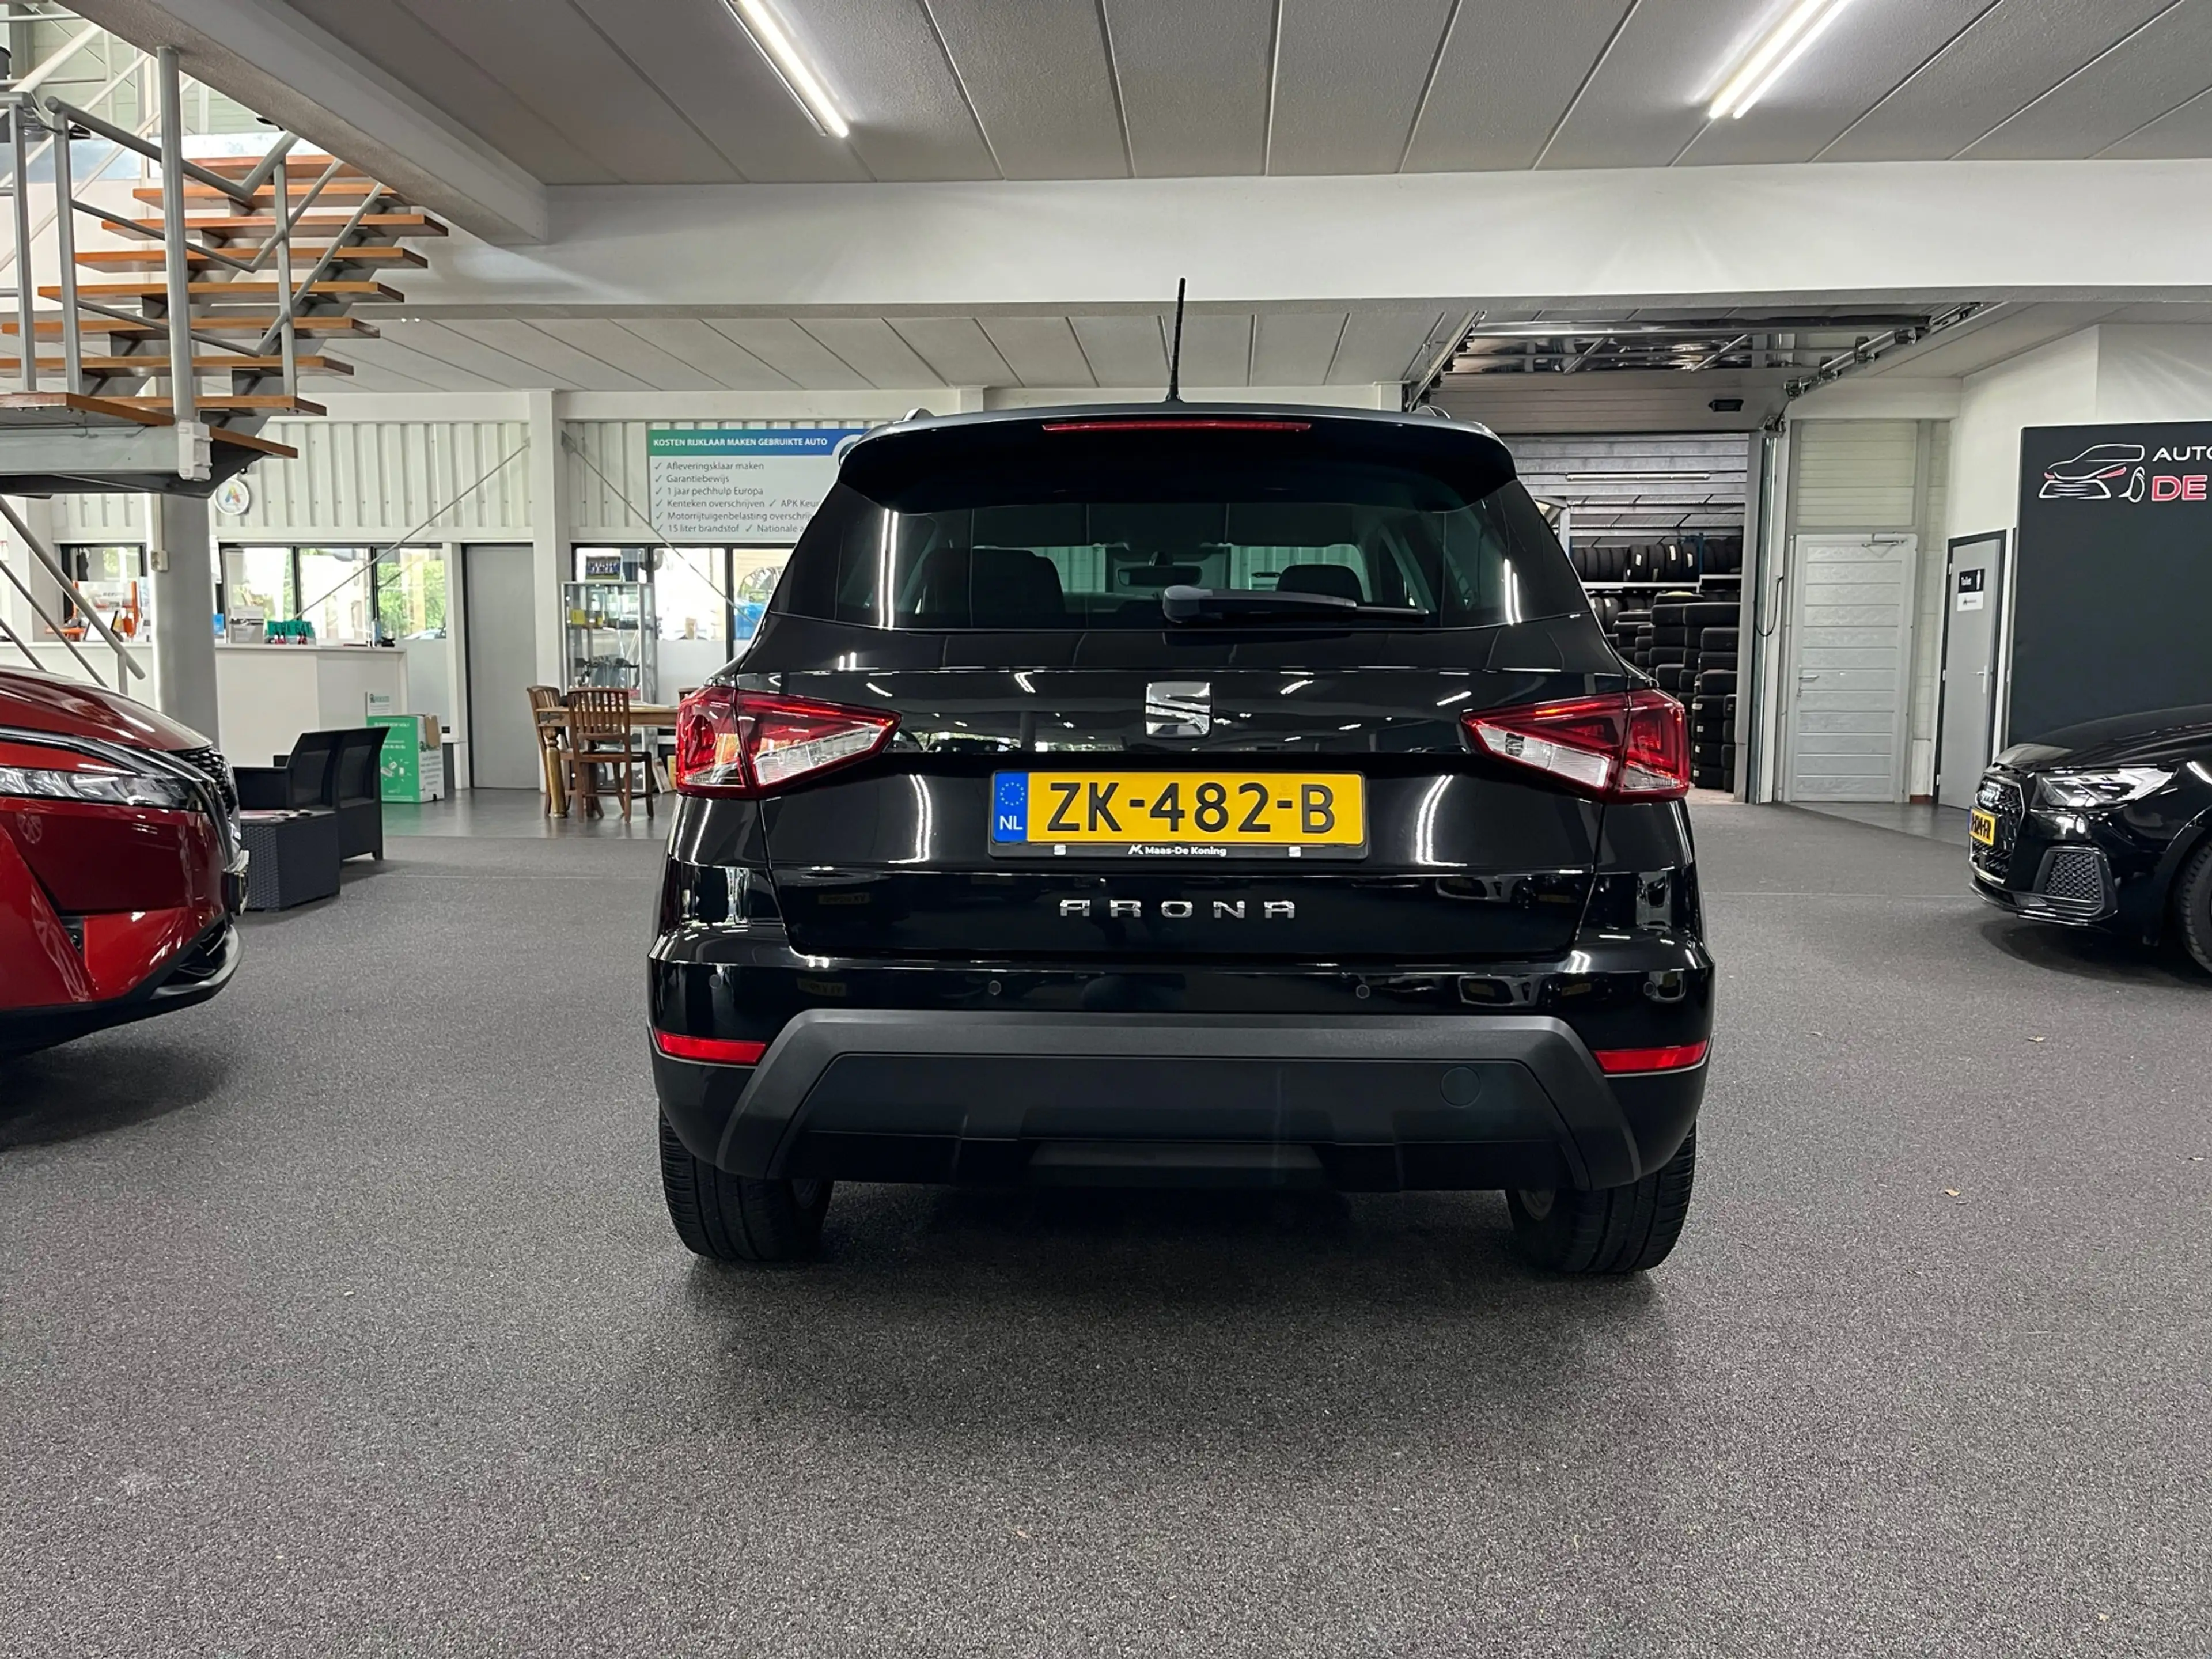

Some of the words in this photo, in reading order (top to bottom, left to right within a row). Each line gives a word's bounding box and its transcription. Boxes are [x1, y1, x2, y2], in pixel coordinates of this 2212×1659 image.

[758, 438, 803, 446] GEBRUIKTE
[666, 461, 733, 472] Afleveringsklaar
[736, 461, 764, 470] maken
[666, 475, 729, 484] Garantiebewijs
[673, 487, 690, 497] jaar
[692, 487, 732, 497] pechhulp
[734, 487, 763, 497] Europa
[2152, 475, 2207, 501] DE
[667, 499, 707, 507] Kenteken
[709, 499, 765, 509] overschrijven
[668, 512, 767, 522] Motorrijtuigenbelasting
[757, 524, 798, 532] Nationale
[1047, 782, 1335, 834] ZK-482-B
[999, 816, 1023, 831] NL
[1145, 846, 1189, 855] Maas-De
[1191, 846, 1227, 857] Koning
[1059, 899, 1296, 918] ARONA
